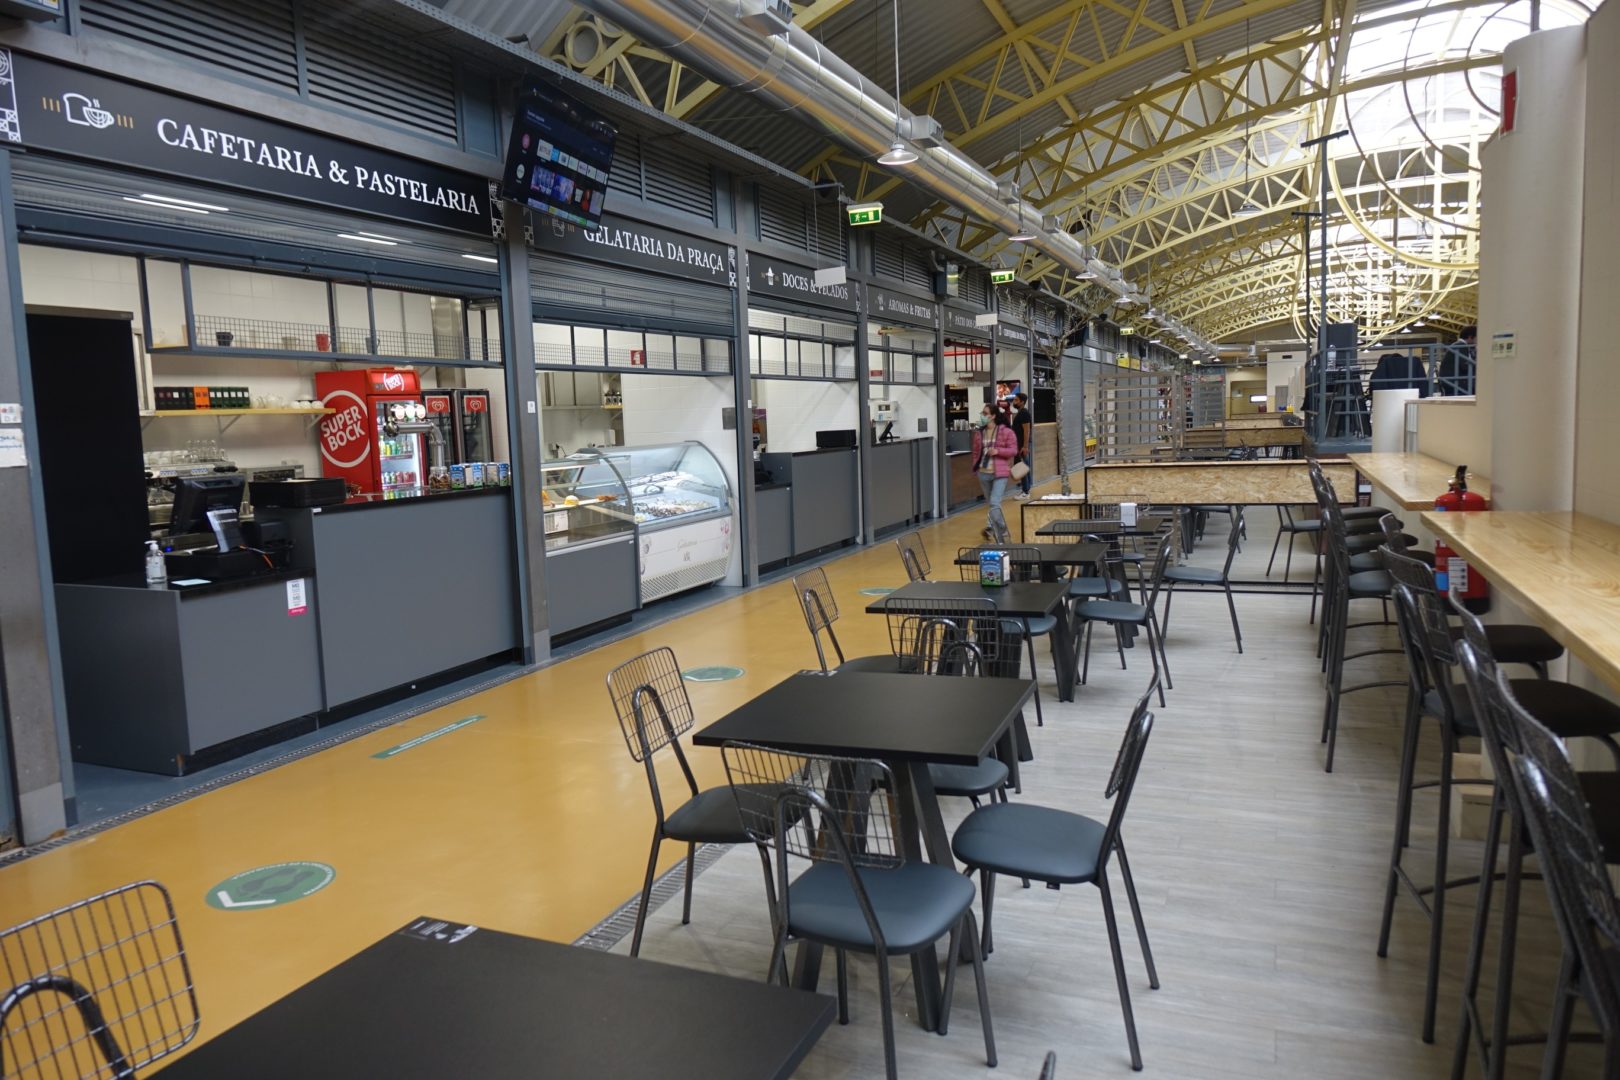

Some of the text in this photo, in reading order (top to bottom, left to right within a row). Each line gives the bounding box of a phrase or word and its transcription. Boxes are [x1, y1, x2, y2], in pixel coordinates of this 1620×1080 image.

[157, 118, 481, 216] CAFETARIA & PASTELARIA
[583, 226, 724, 274] GELATARIA DA PRAÇA
[782, 272, 849, 300] DOCES & PECADOS
[888, 299, 909, 314] AROMAS
[914, 305, 931, 319] FRUTAS
[320, 405, 362, 437] SUPER
[327, 421, 365, 451] BOCK
